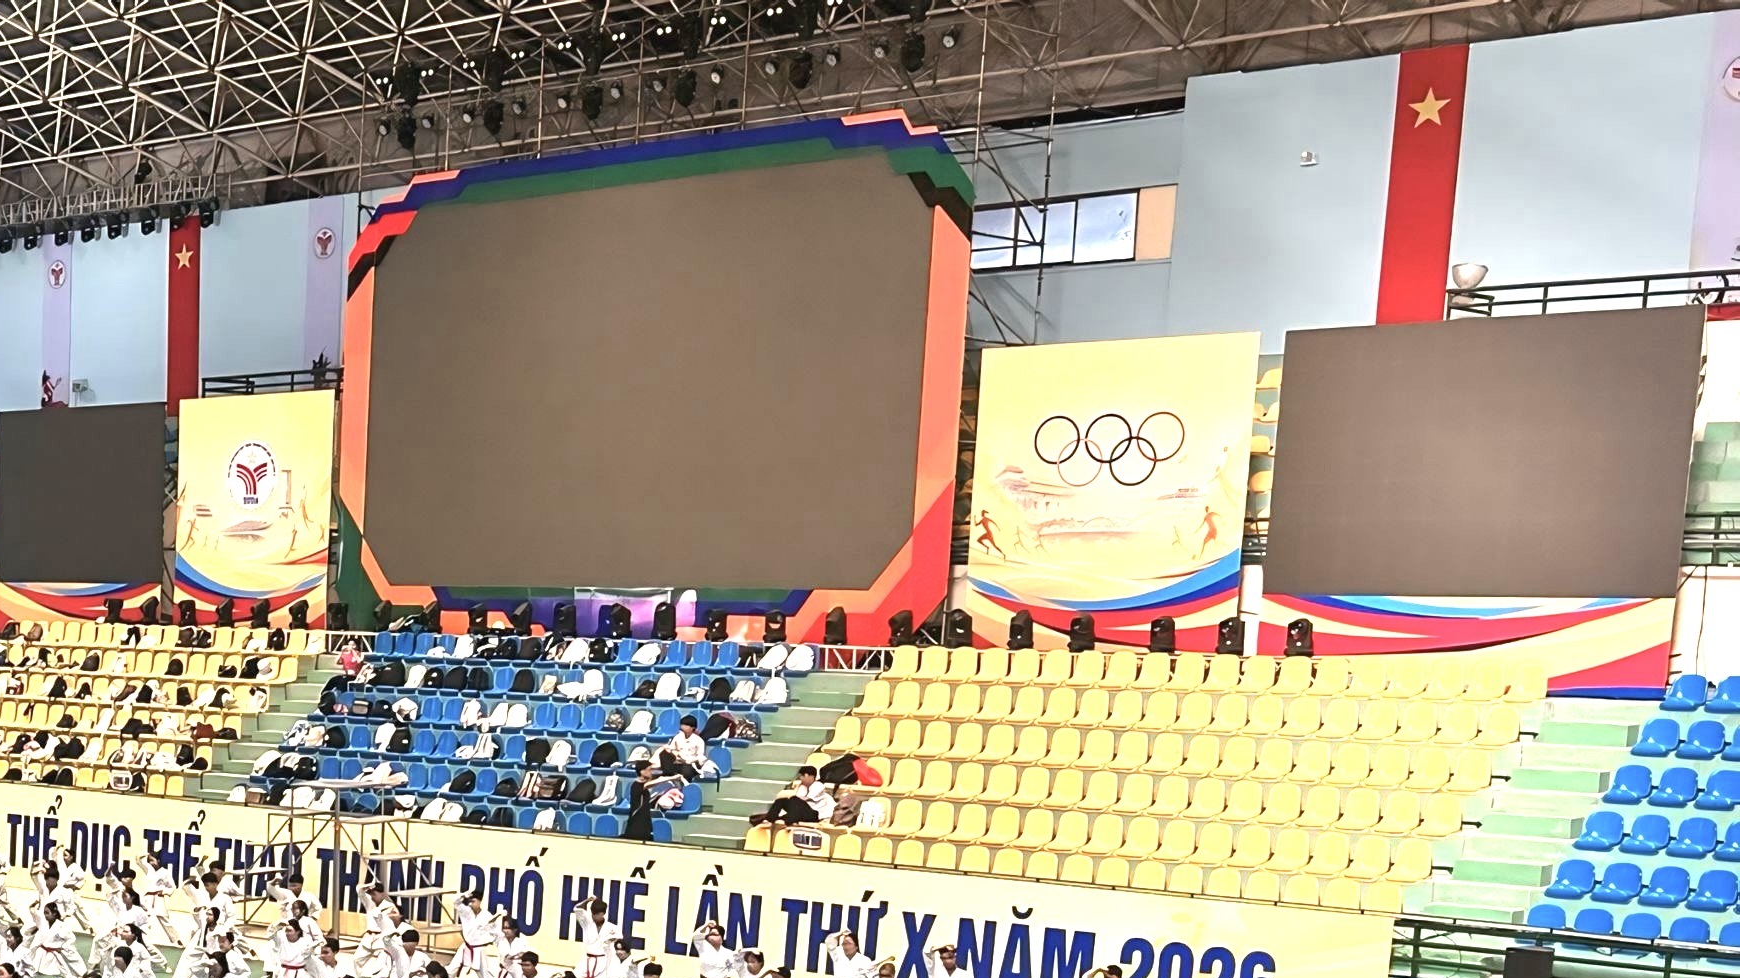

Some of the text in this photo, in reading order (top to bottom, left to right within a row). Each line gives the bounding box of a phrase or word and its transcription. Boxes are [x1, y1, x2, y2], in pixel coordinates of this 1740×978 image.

[70, 821, 131, 892] DỤC
[459, 847, 549, 936] PHỐ
[664, 864, 763, 958] LẦN
[781, 890, 889, 975] THỨ
